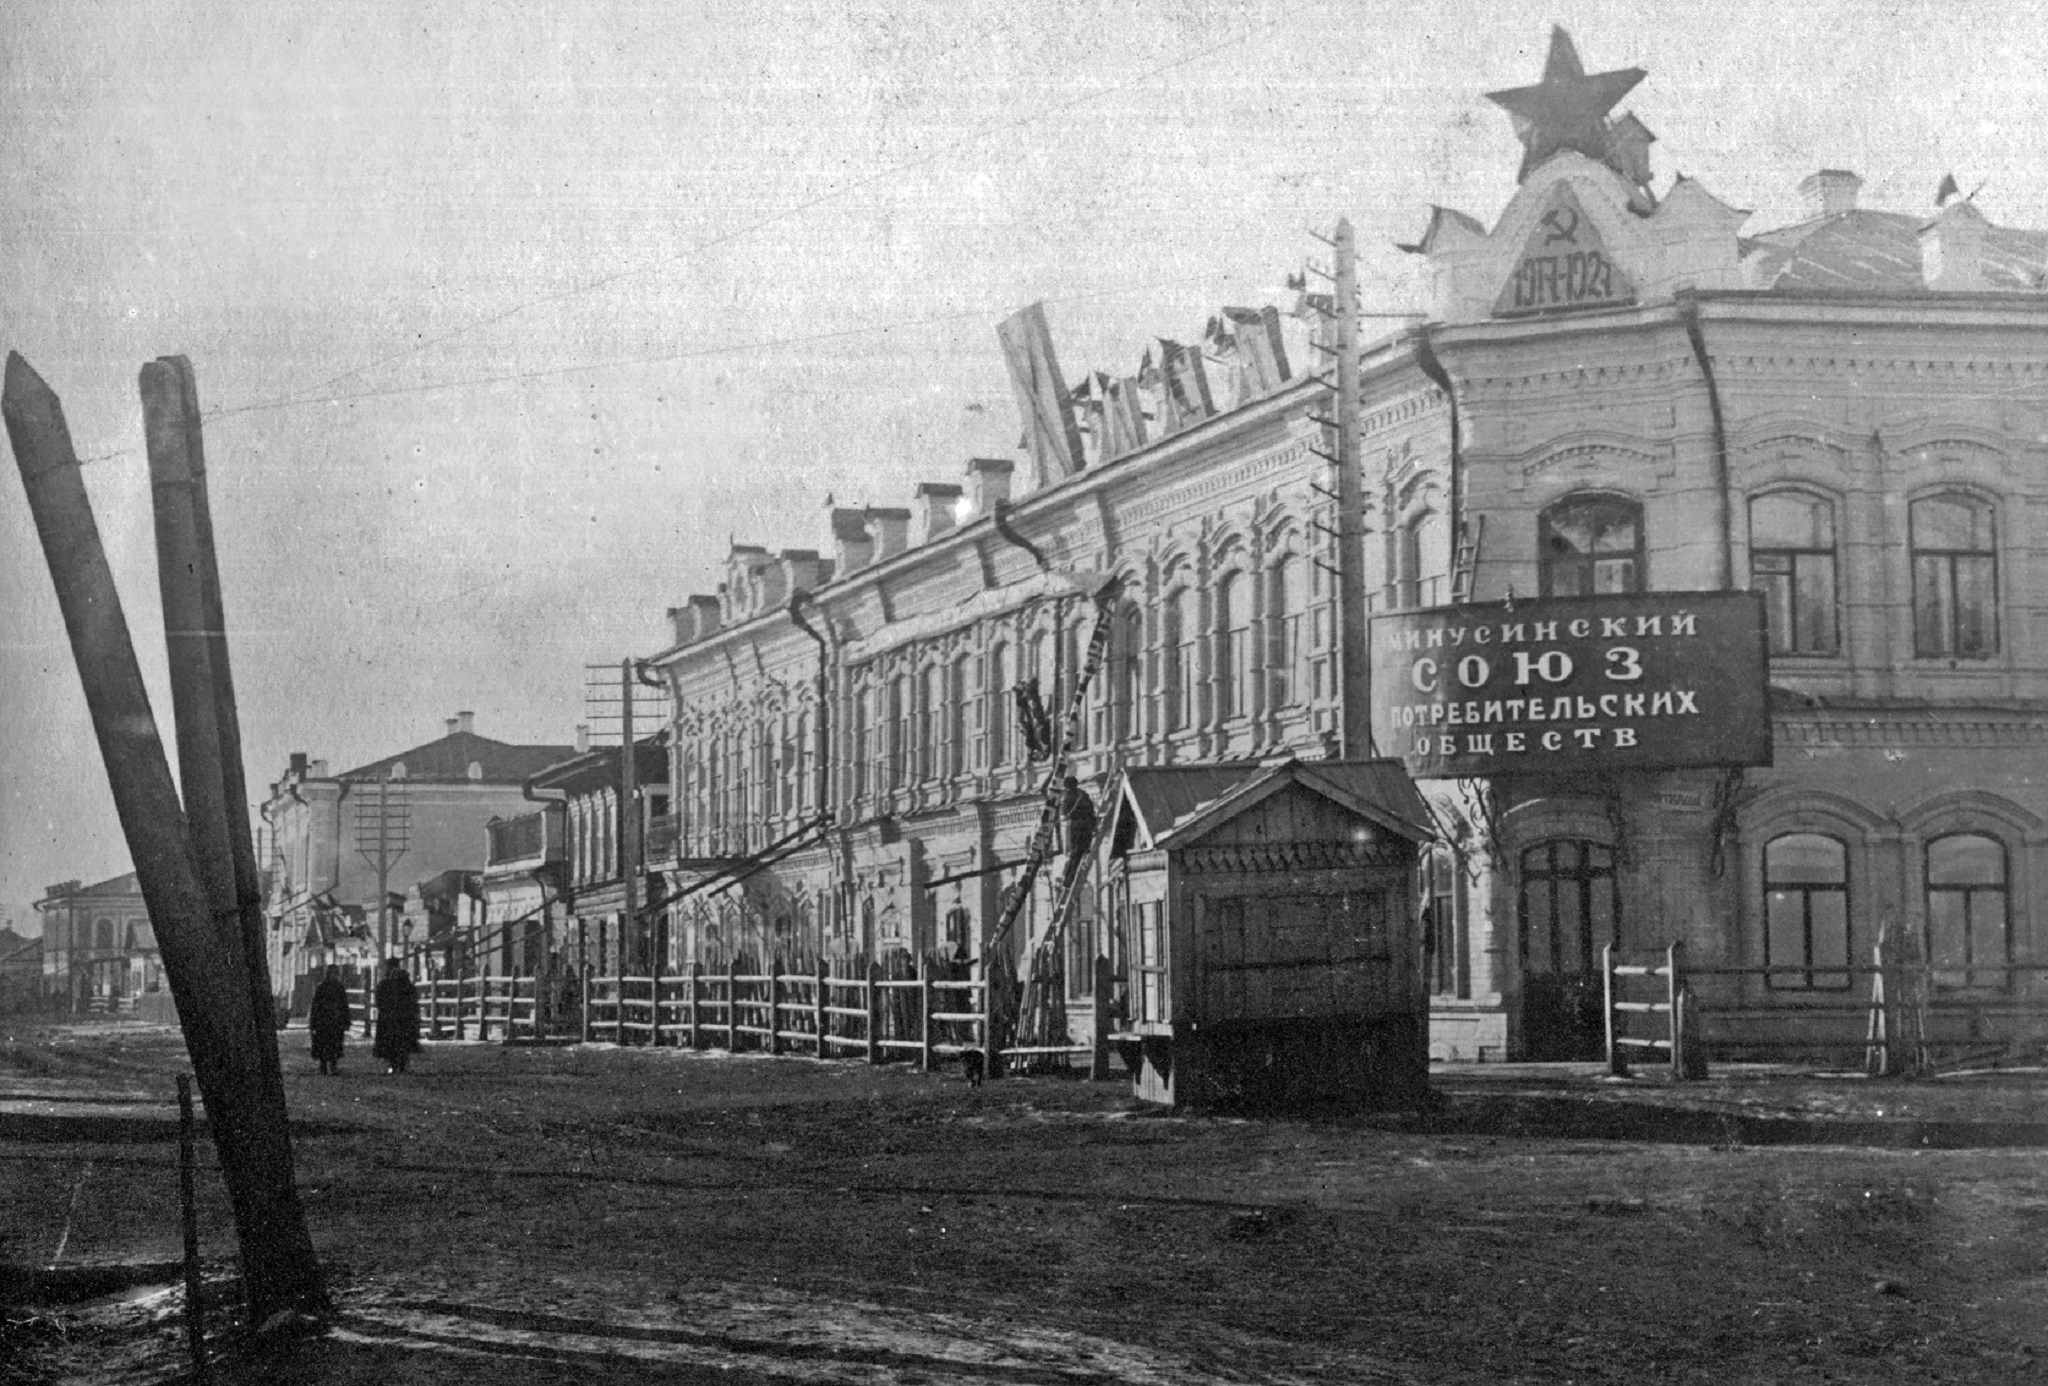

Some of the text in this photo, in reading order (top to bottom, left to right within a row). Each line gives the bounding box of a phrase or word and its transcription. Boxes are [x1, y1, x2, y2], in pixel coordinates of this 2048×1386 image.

[1412, 646, 1643, 692] СОЮЗ
[1390, 690, 1699, 728] ПОТРЕБИТЕЛЬСКИХ
[1416, 727, 1638, 756] ОБЩЕСТВ
